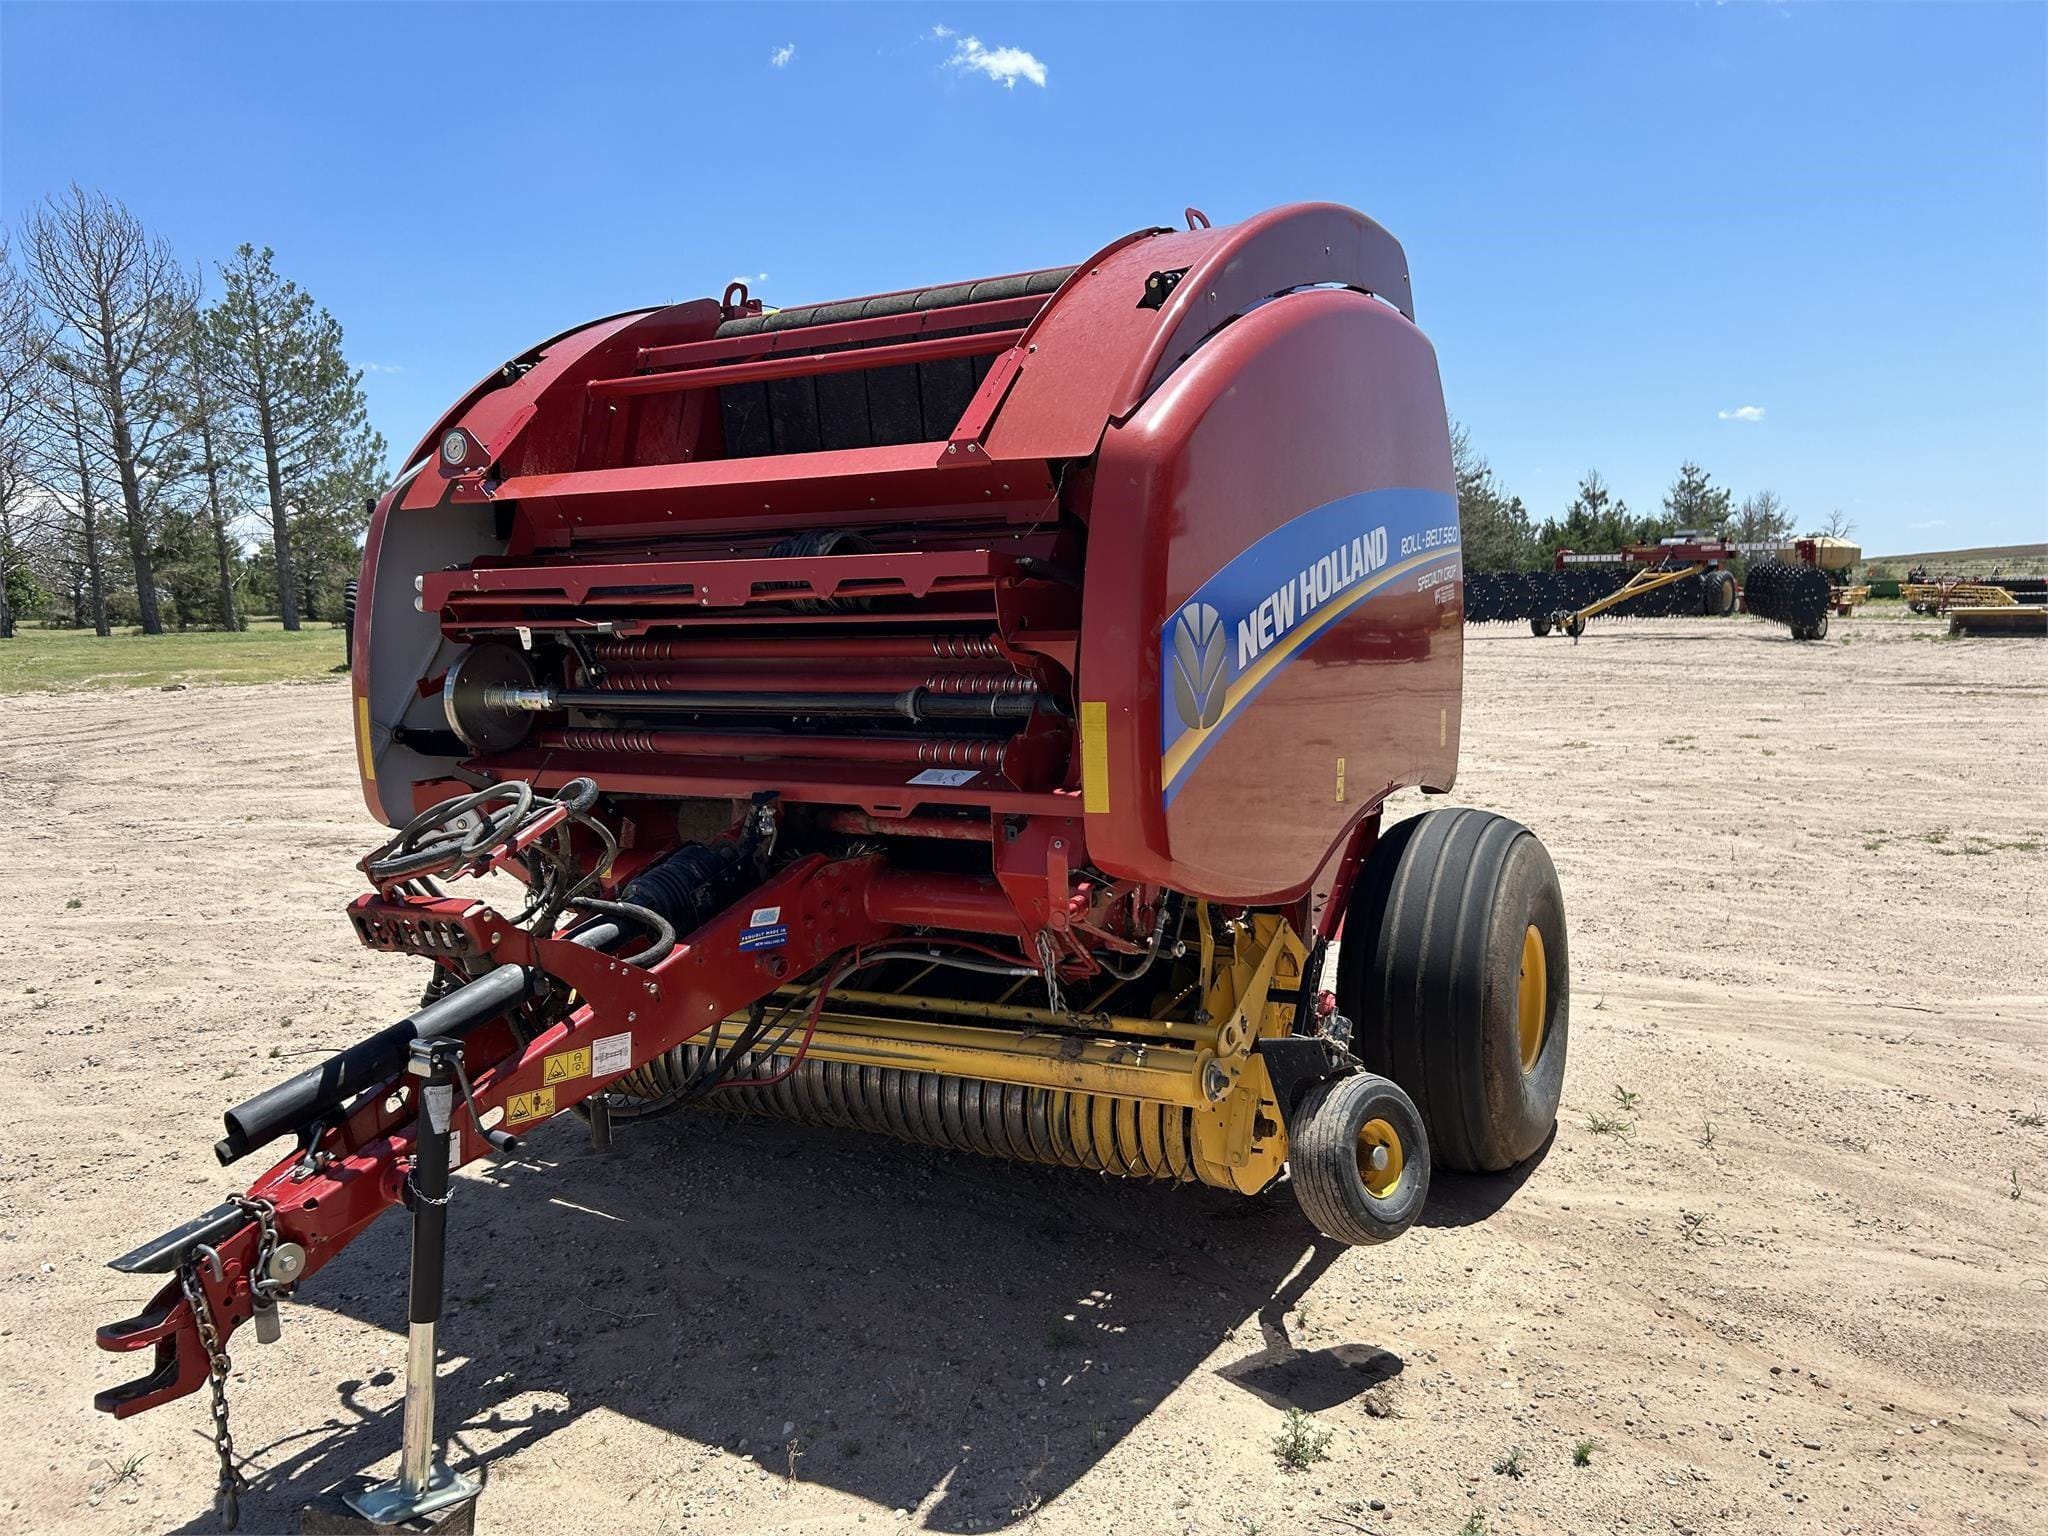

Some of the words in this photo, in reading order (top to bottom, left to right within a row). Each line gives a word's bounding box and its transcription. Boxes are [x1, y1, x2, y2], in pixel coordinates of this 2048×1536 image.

[1443, 526, 1458, 545] 560
[1417, 567, 1444, 593] SPECIALTY
[1238, 578, 1296, 671] NEW
[1300, 526, 1388, 617] HOLLAND
